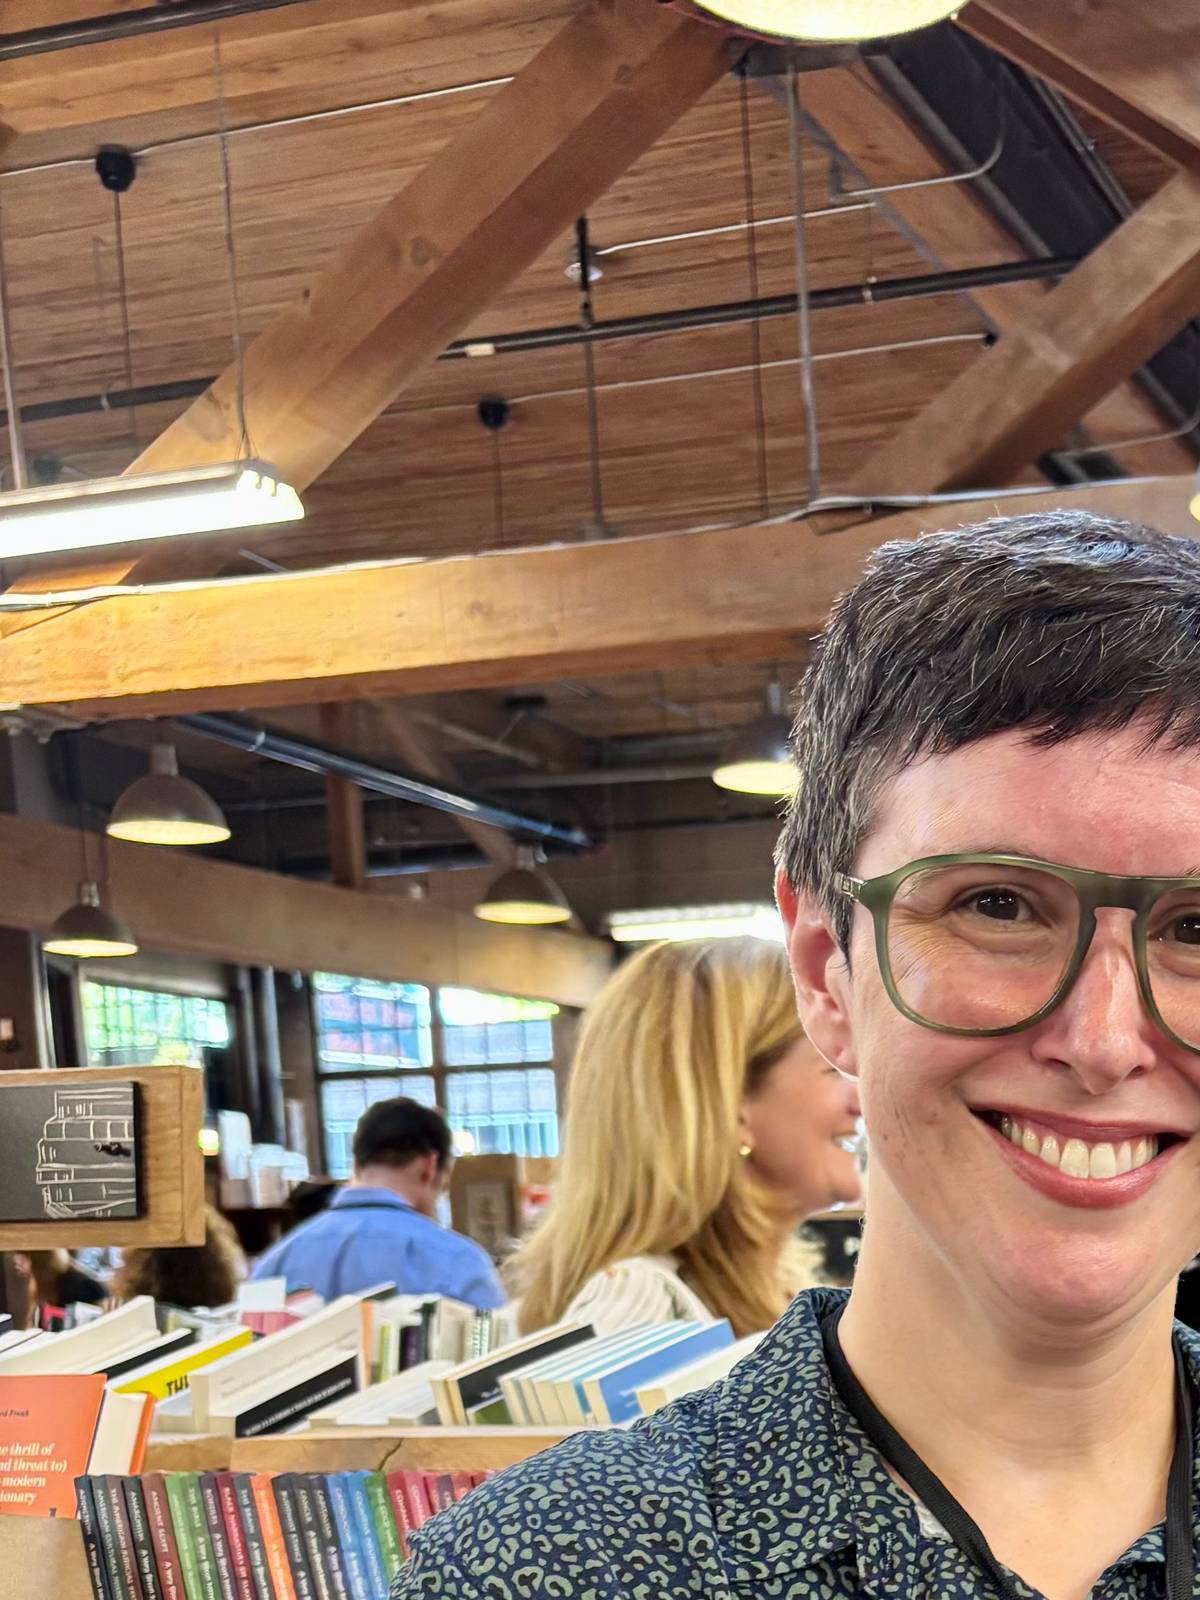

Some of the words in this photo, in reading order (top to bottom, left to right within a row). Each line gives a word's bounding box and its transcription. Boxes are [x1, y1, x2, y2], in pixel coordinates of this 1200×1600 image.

[10, 1442, 40, 1456] thrill
[41, 1442, 55, 1456] of
[13, 1458, 50, 1473] threat
[50, 1459, 67, 1474] to)
[2, 1473, 46, 1488] modern
